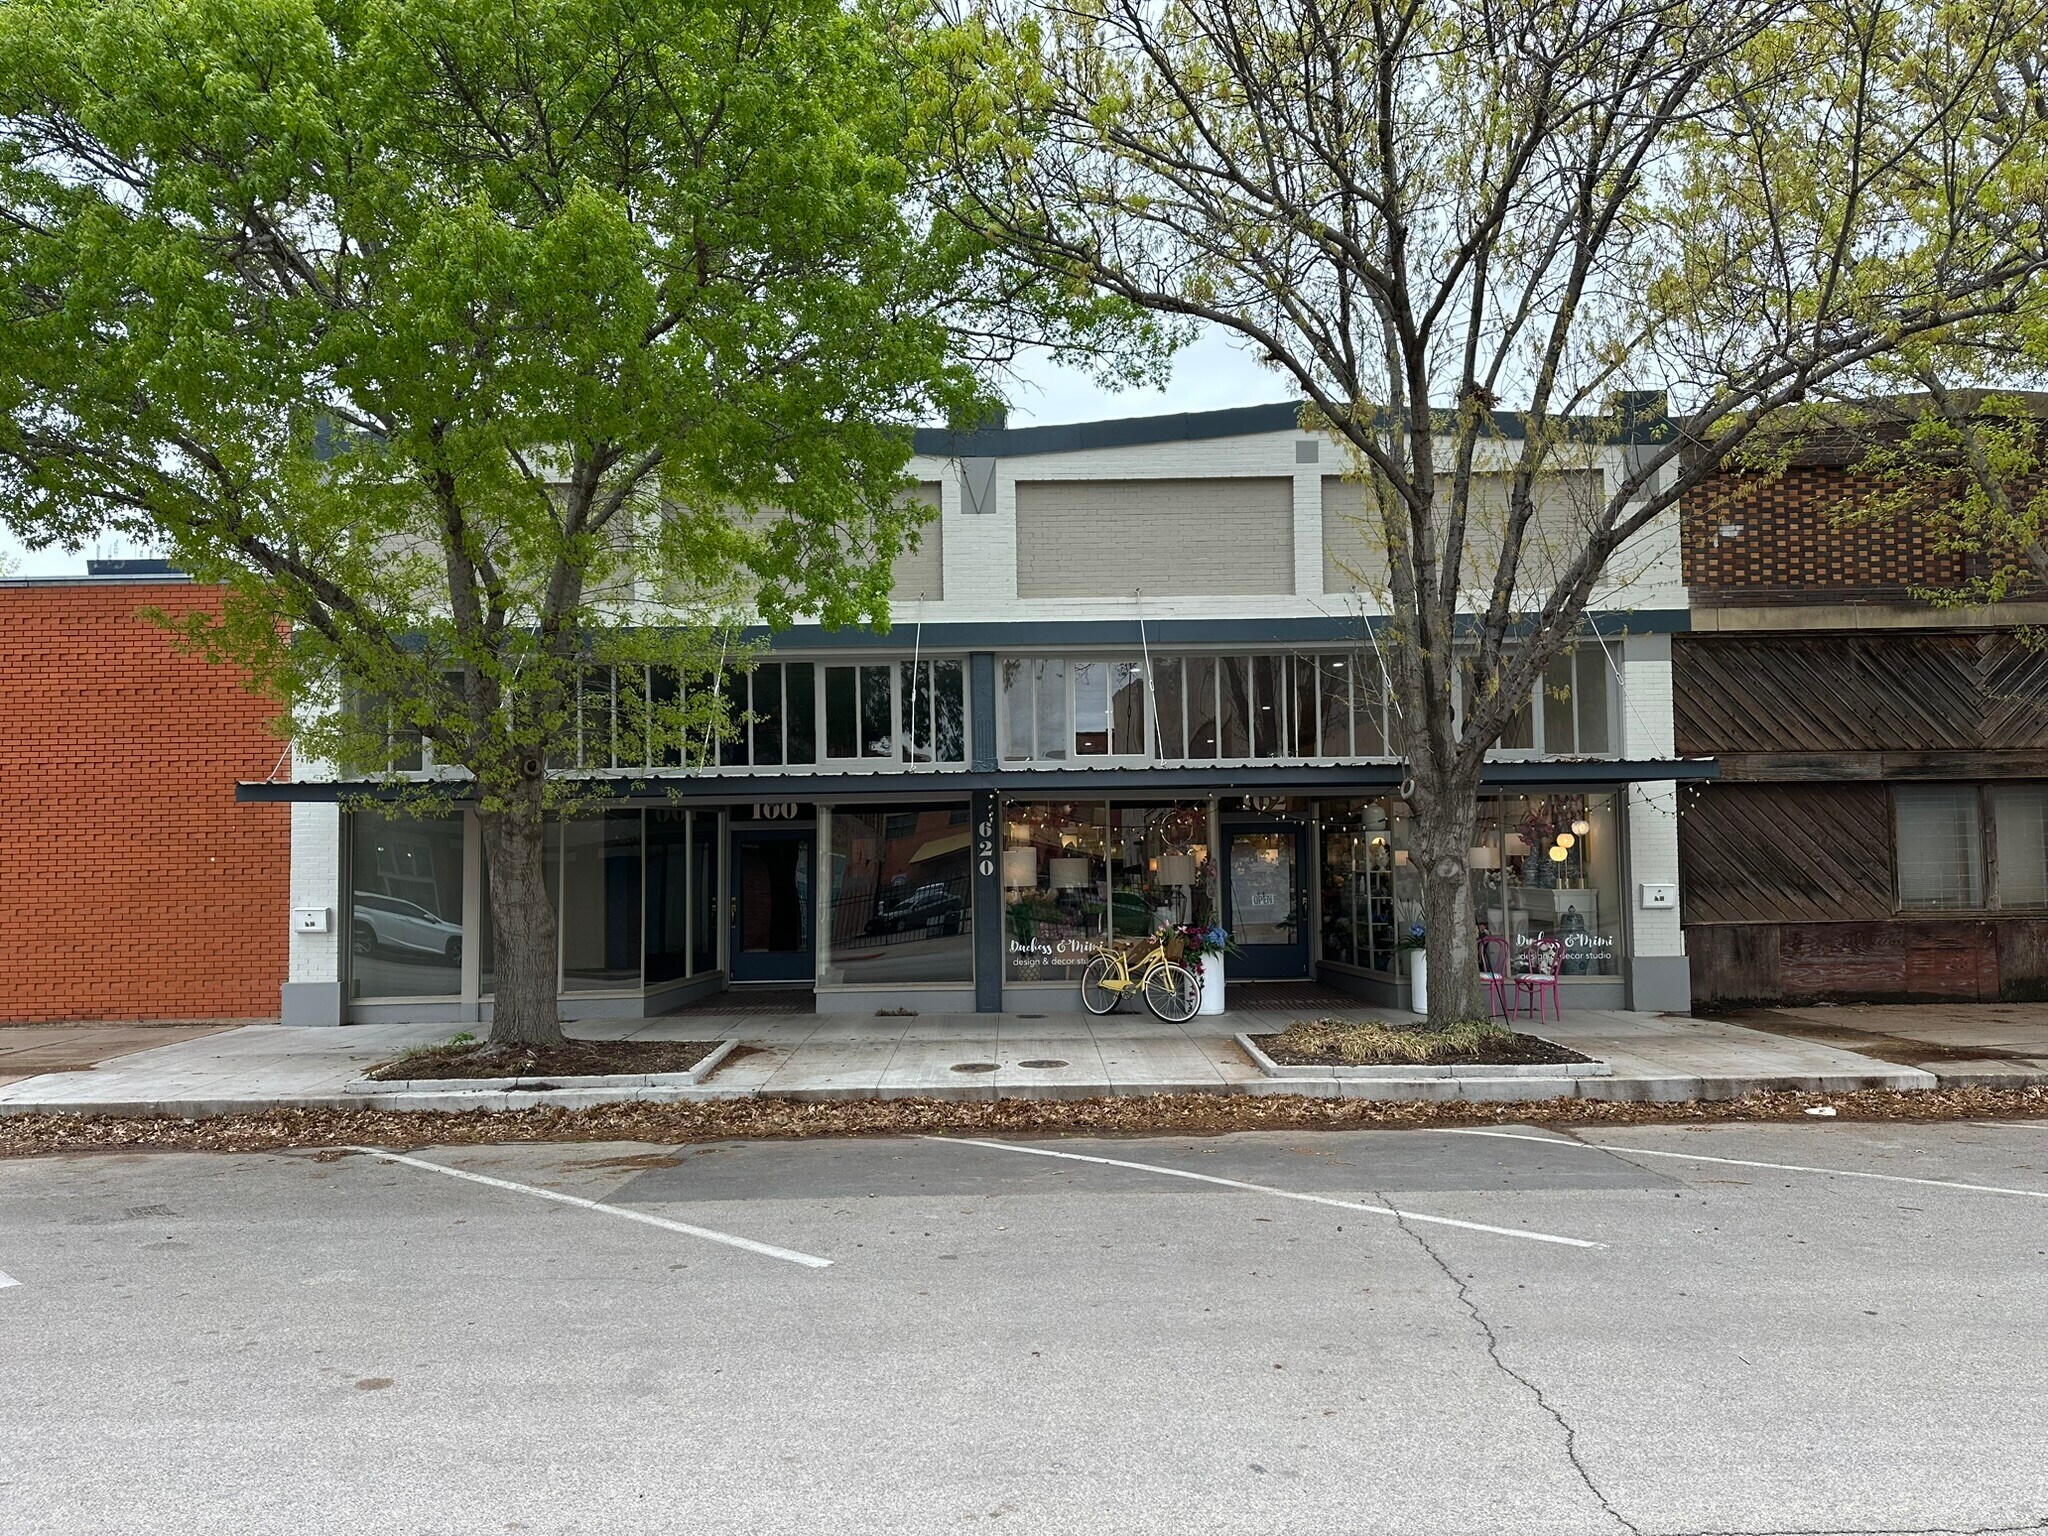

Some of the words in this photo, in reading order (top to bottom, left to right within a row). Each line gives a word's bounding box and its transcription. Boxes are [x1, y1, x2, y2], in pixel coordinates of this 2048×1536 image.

[1241, 796, 1287, 811] 102
[752, 803, 798, 820] 100
[979, 821, 994, 876] 620
[1253, 894, 1273, 905] OPEN
[1009, 937, 1052, 955] Duchess
[1056, 940, 1071, 953] &
[1565, 934, 1580, 948] &
[1580, 933, 1613, 948] Mimi
[1013, 958, 1041, 968] design
[1042, 957, 1049, 966] &
[1052, 957, 1074, 966] decor
[1585, 952, 1612, 960] studio
